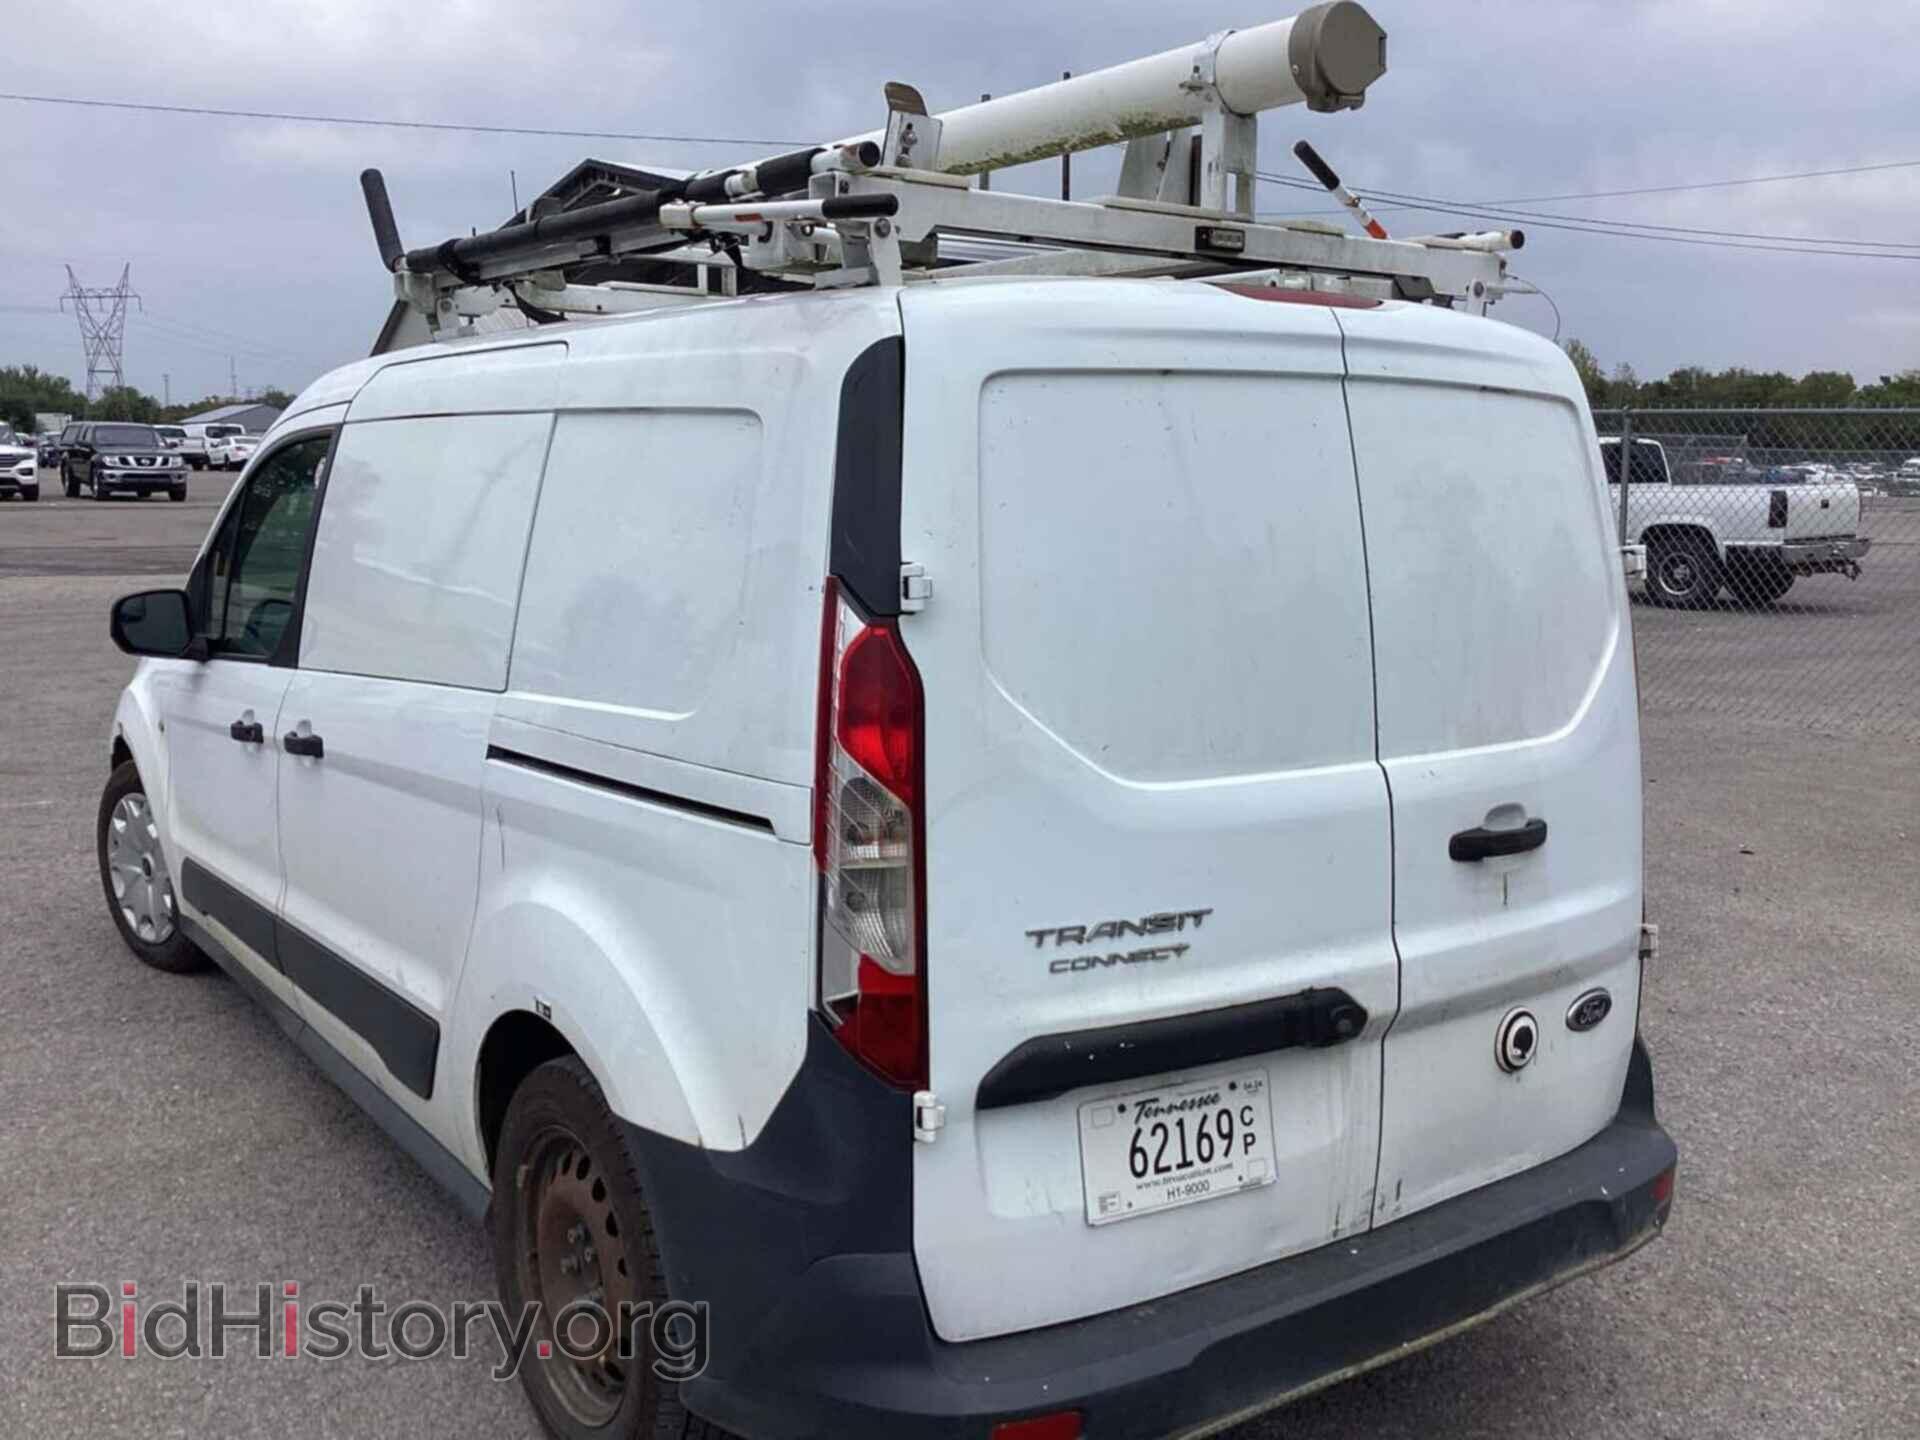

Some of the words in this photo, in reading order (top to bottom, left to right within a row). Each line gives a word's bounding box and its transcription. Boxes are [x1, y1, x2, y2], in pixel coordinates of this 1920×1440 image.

[1025, 908, 1213, 948] TRANSIT
[1048, 943, 1190, 974] CONNECT
[1133, 1092, 1221, 1125] Tennessee
[1129, 1108, 1234, 1179] 62169
[1167, 1180, 1210, 1200] H1-9000
